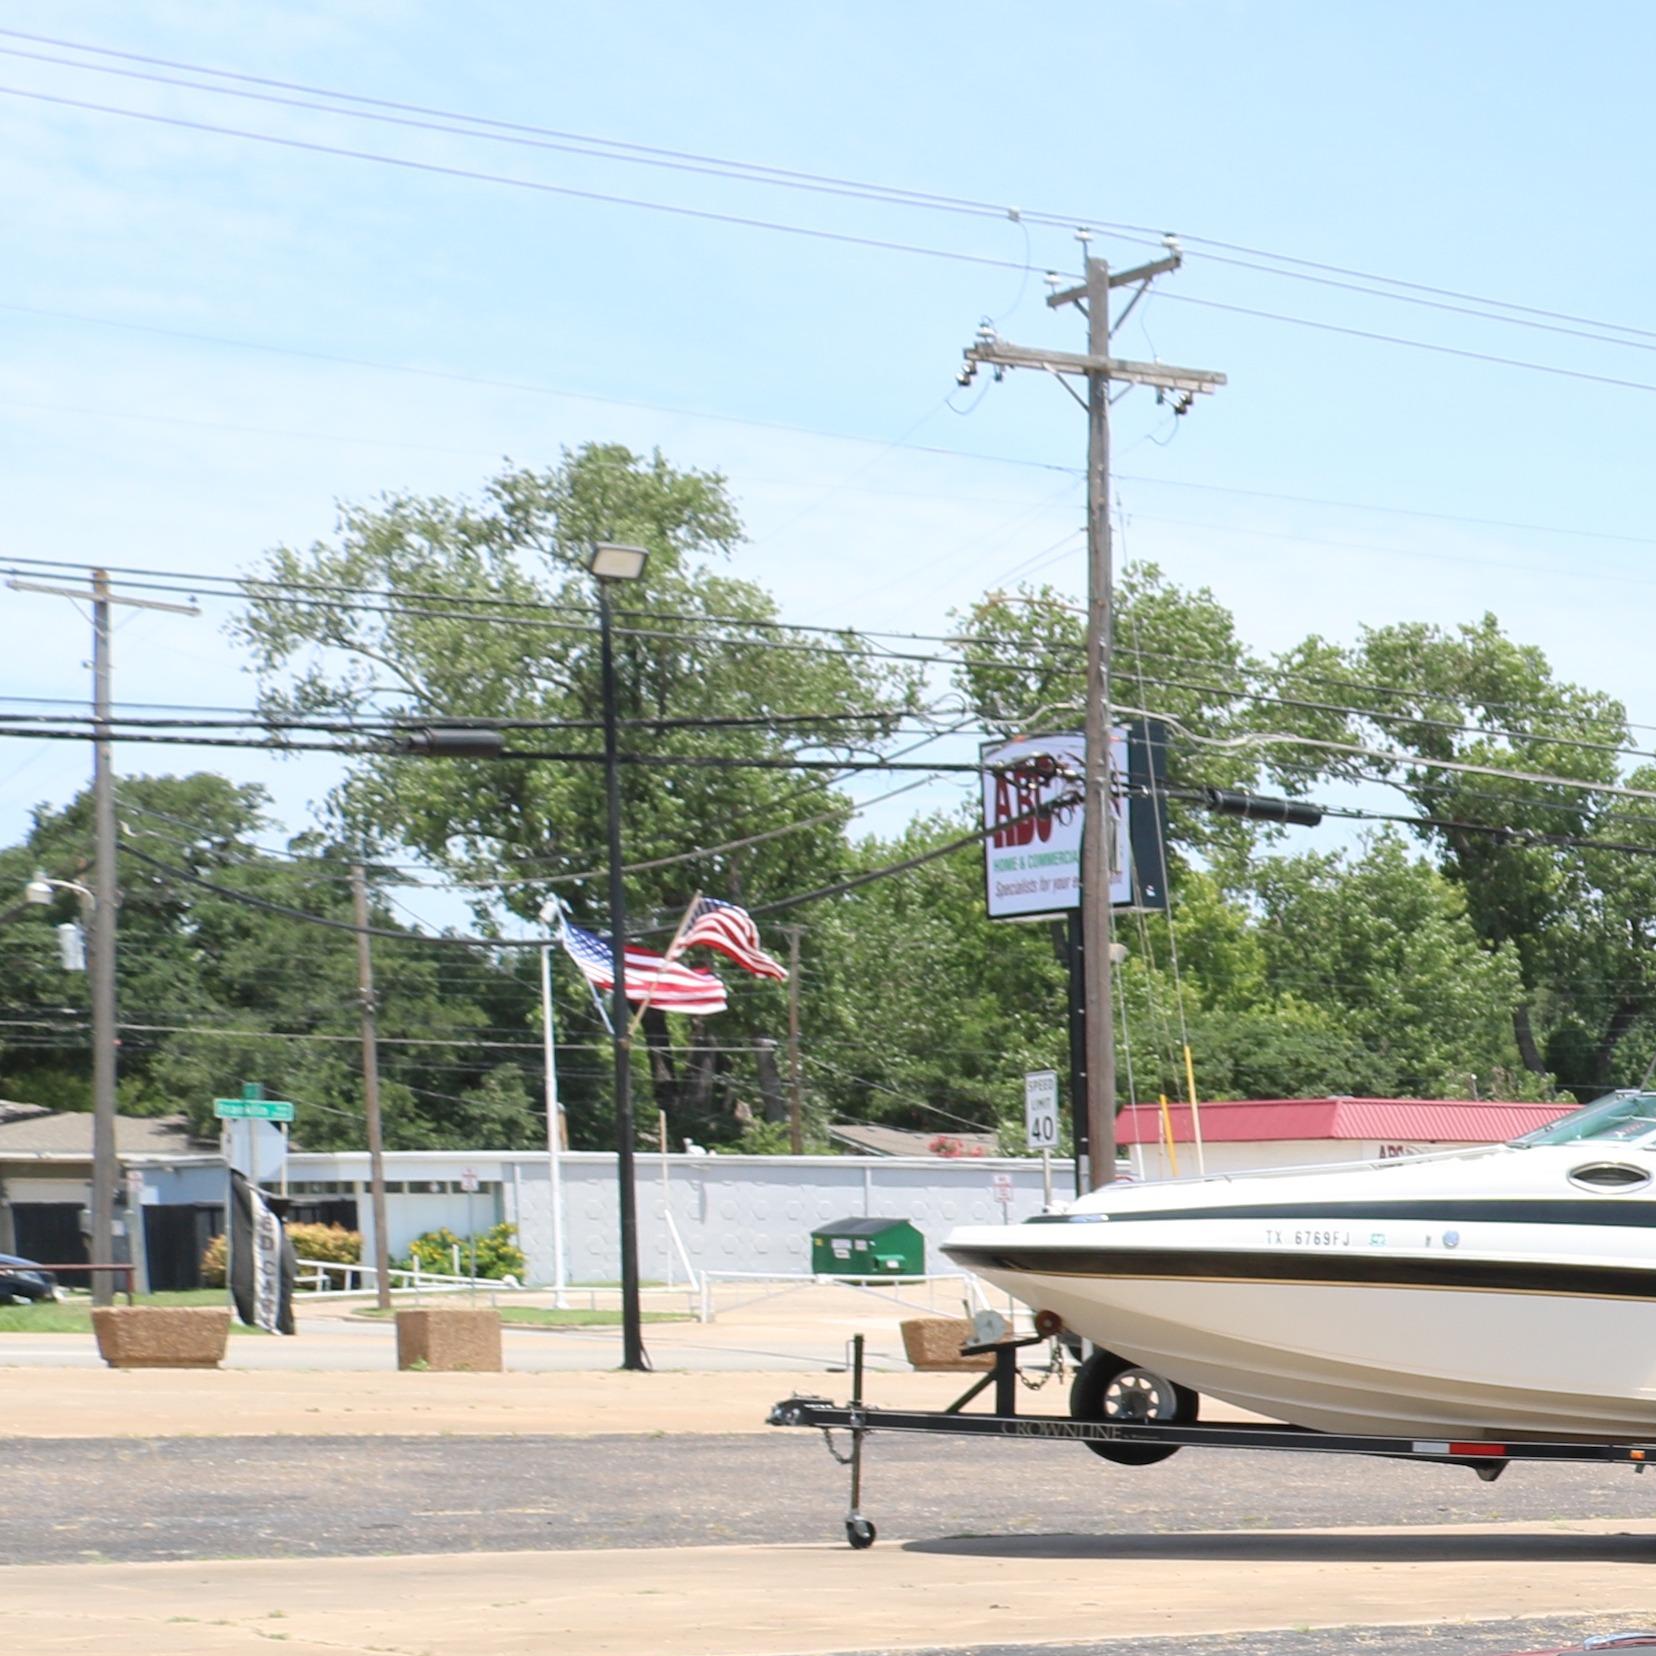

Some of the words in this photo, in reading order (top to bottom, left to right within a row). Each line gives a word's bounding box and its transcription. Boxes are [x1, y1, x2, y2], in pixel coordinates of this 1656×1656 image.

[994, 755, 1055, 848] ABC
[1027, 850, 1079, 869] COMMERCIA
[1027, 1078, 1053, 1092] SPEED
[1030, 1097, 1052, 1111] LIMIT
[1031, 1116, 1053, 1141] 40
[1266, 1230, 1282, 1245] TX
[1295, 1231, 1350, 1247] 6769FJ
[1002, 1420, 1122, 1440] CROWNLINE
